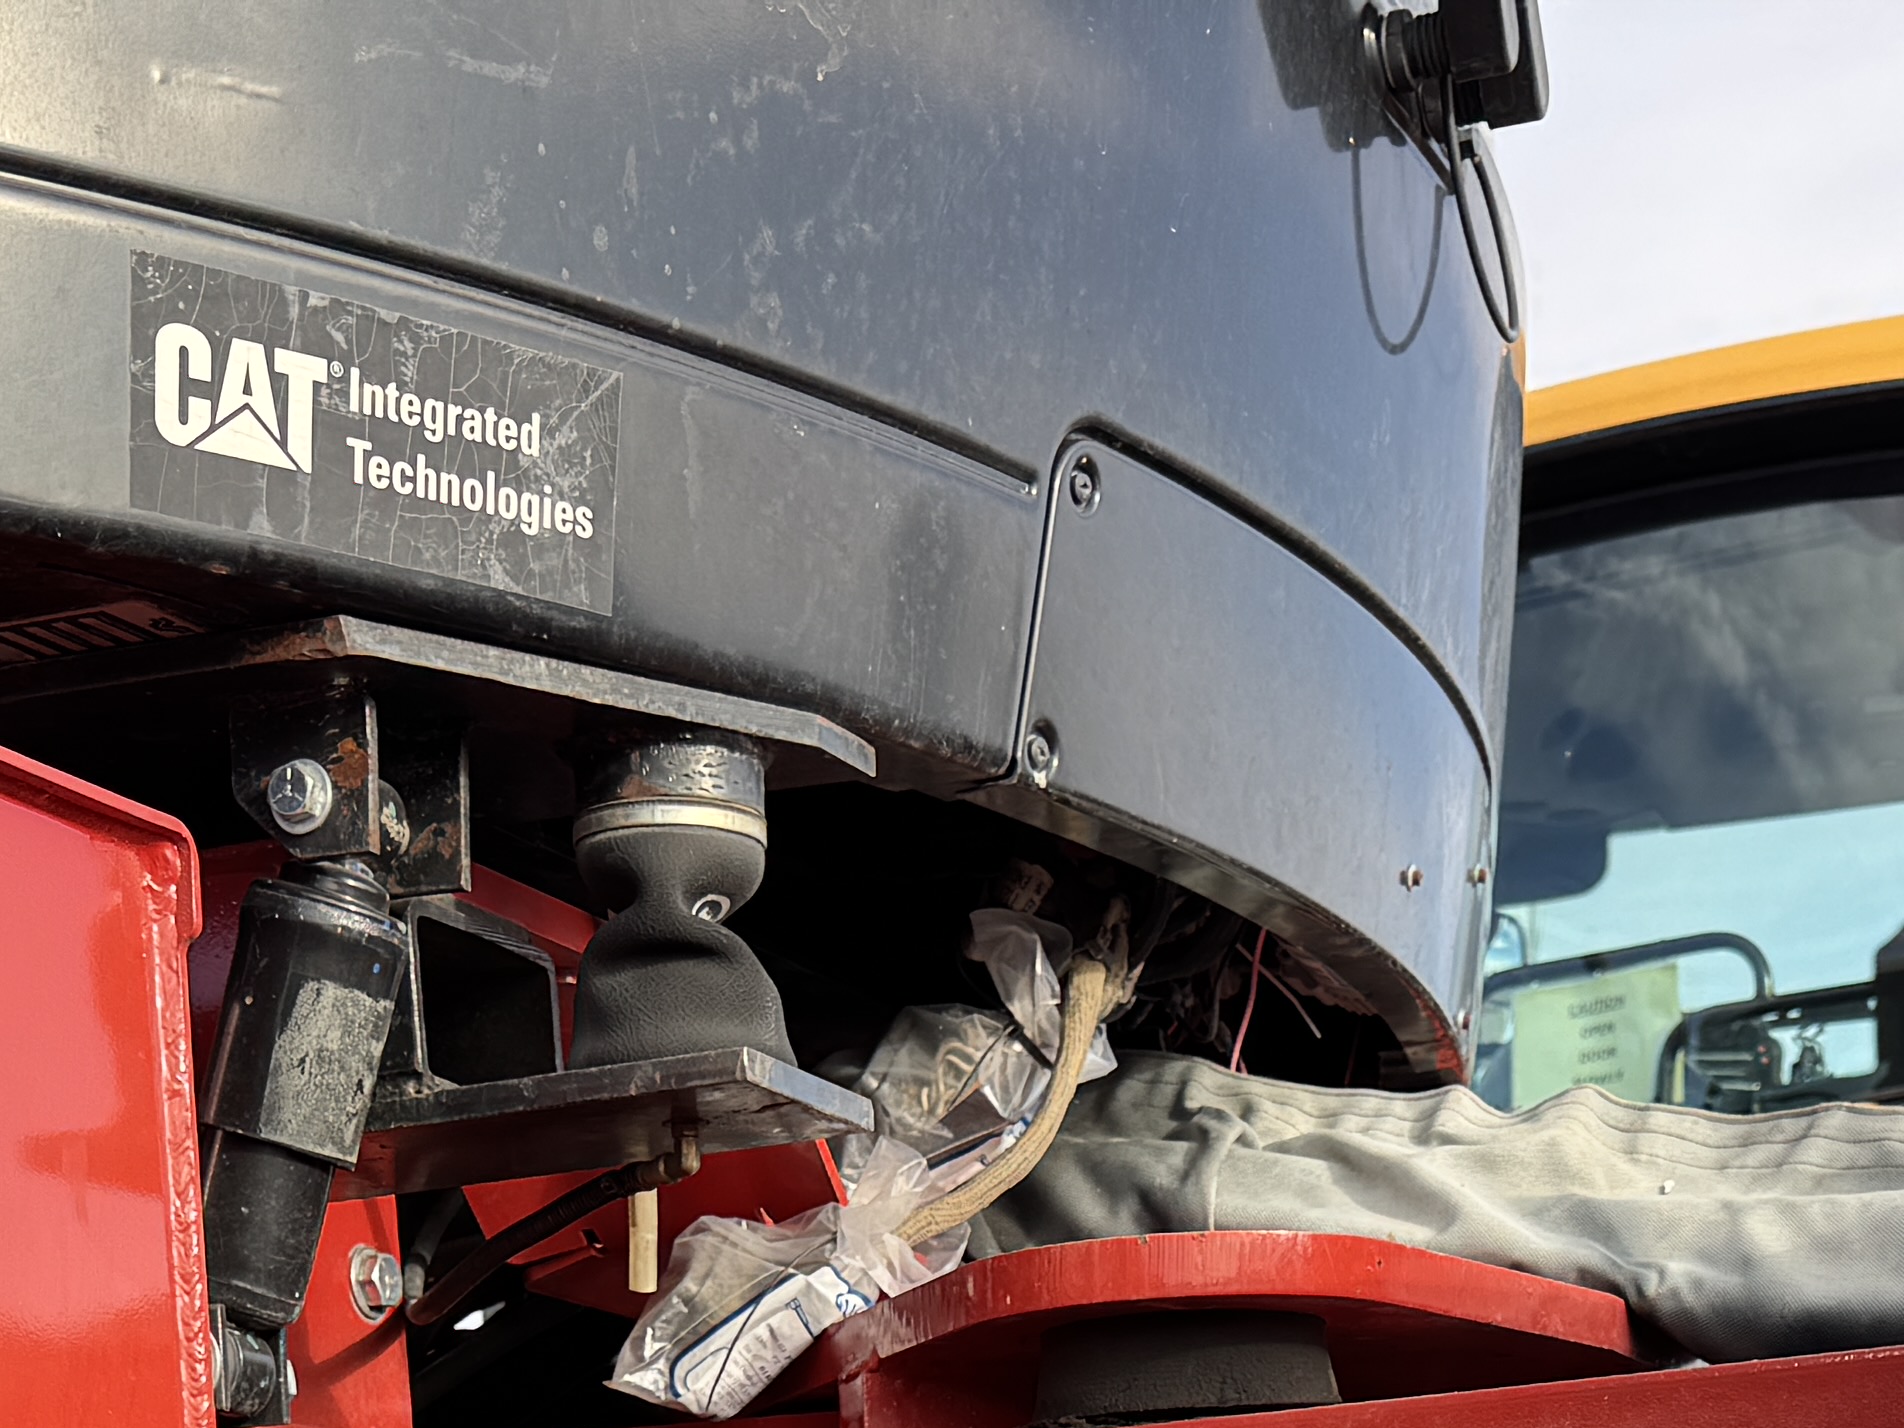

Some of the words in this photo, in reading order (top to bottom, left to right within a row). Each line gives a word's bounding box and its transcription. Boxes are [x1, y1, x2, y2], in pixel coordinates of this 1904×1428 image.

[154, 322, 328, 474] CAT
[349, 366, 541, 458] Integrated
[346, 437, 594, 539] Technologies
